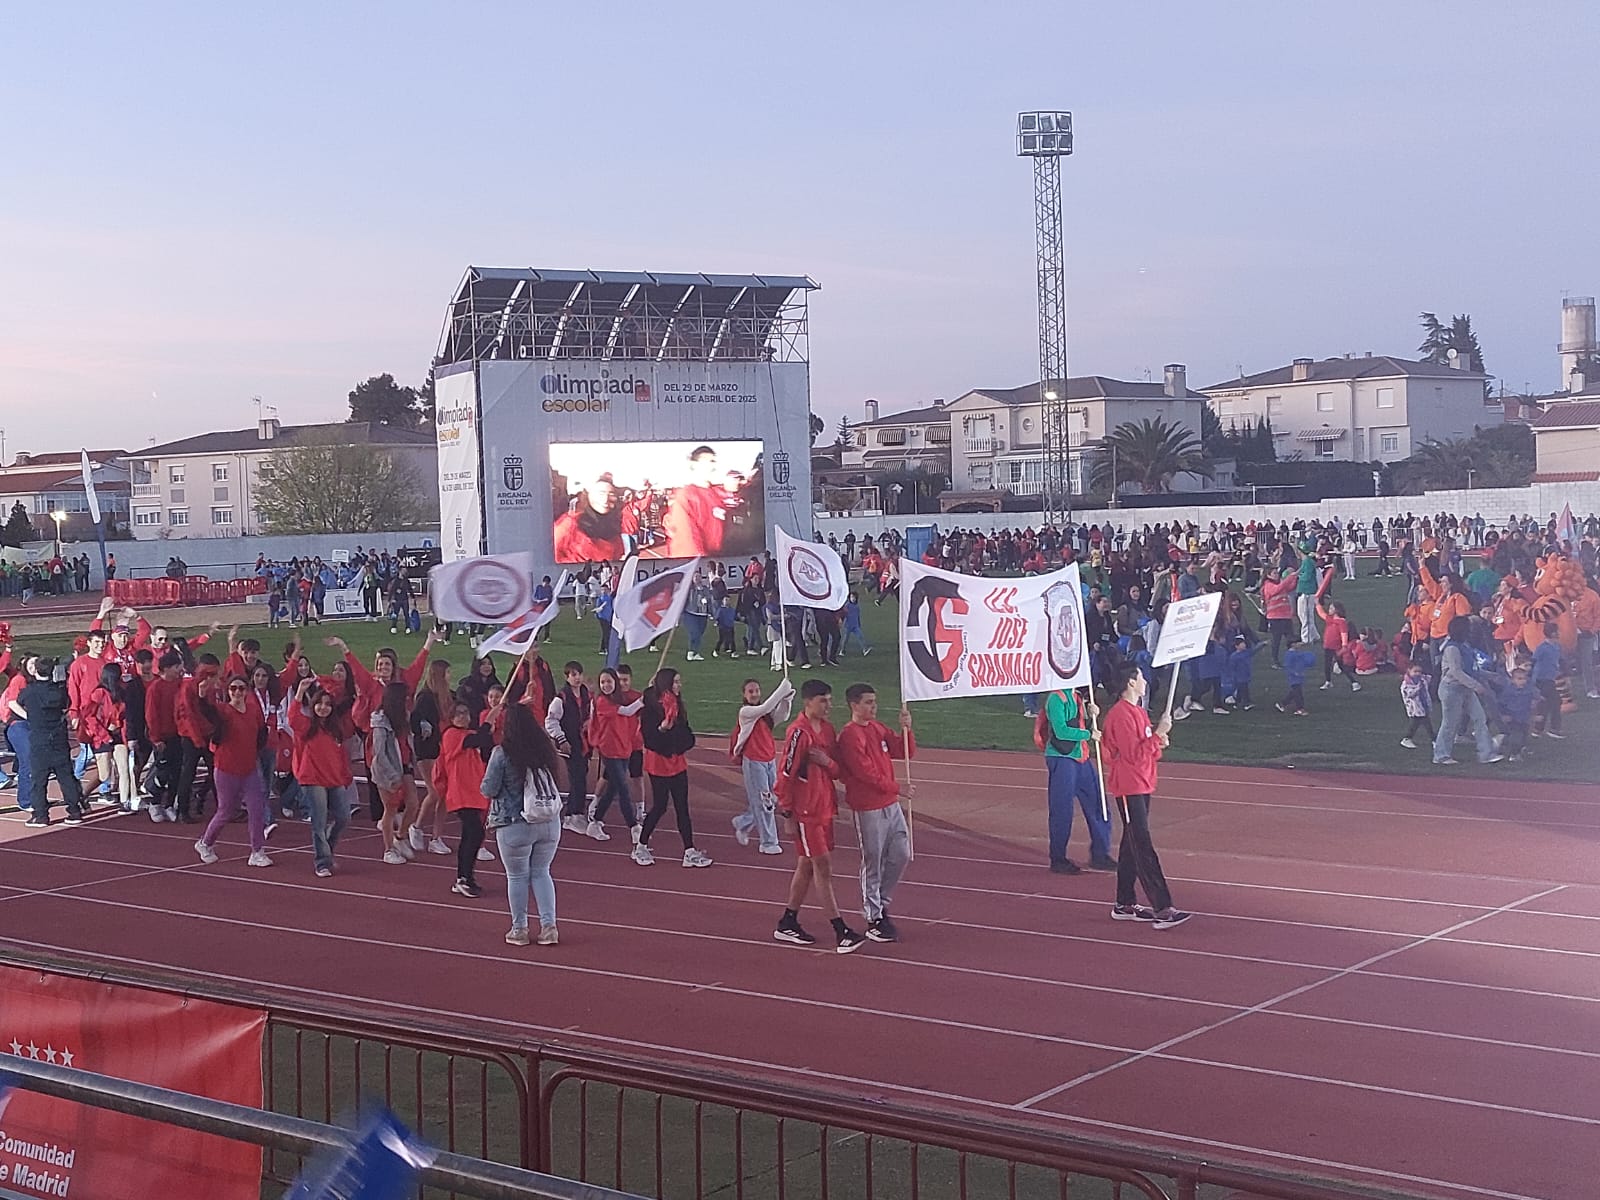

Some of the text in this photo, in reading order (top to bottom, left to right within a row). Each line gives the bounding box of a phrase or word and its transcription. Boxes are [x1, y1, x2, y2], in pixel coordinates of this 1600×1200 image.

[542, 394, 611, 412] escolar
[664, 395, 757, 403] AL 6 DE ABRIL DE 2025
[968, 651, 1042, 688] SARAMAGO
[0, 1131, 75, 1168] Comunidad
[12, 1163, 70, 1197] Madrid
